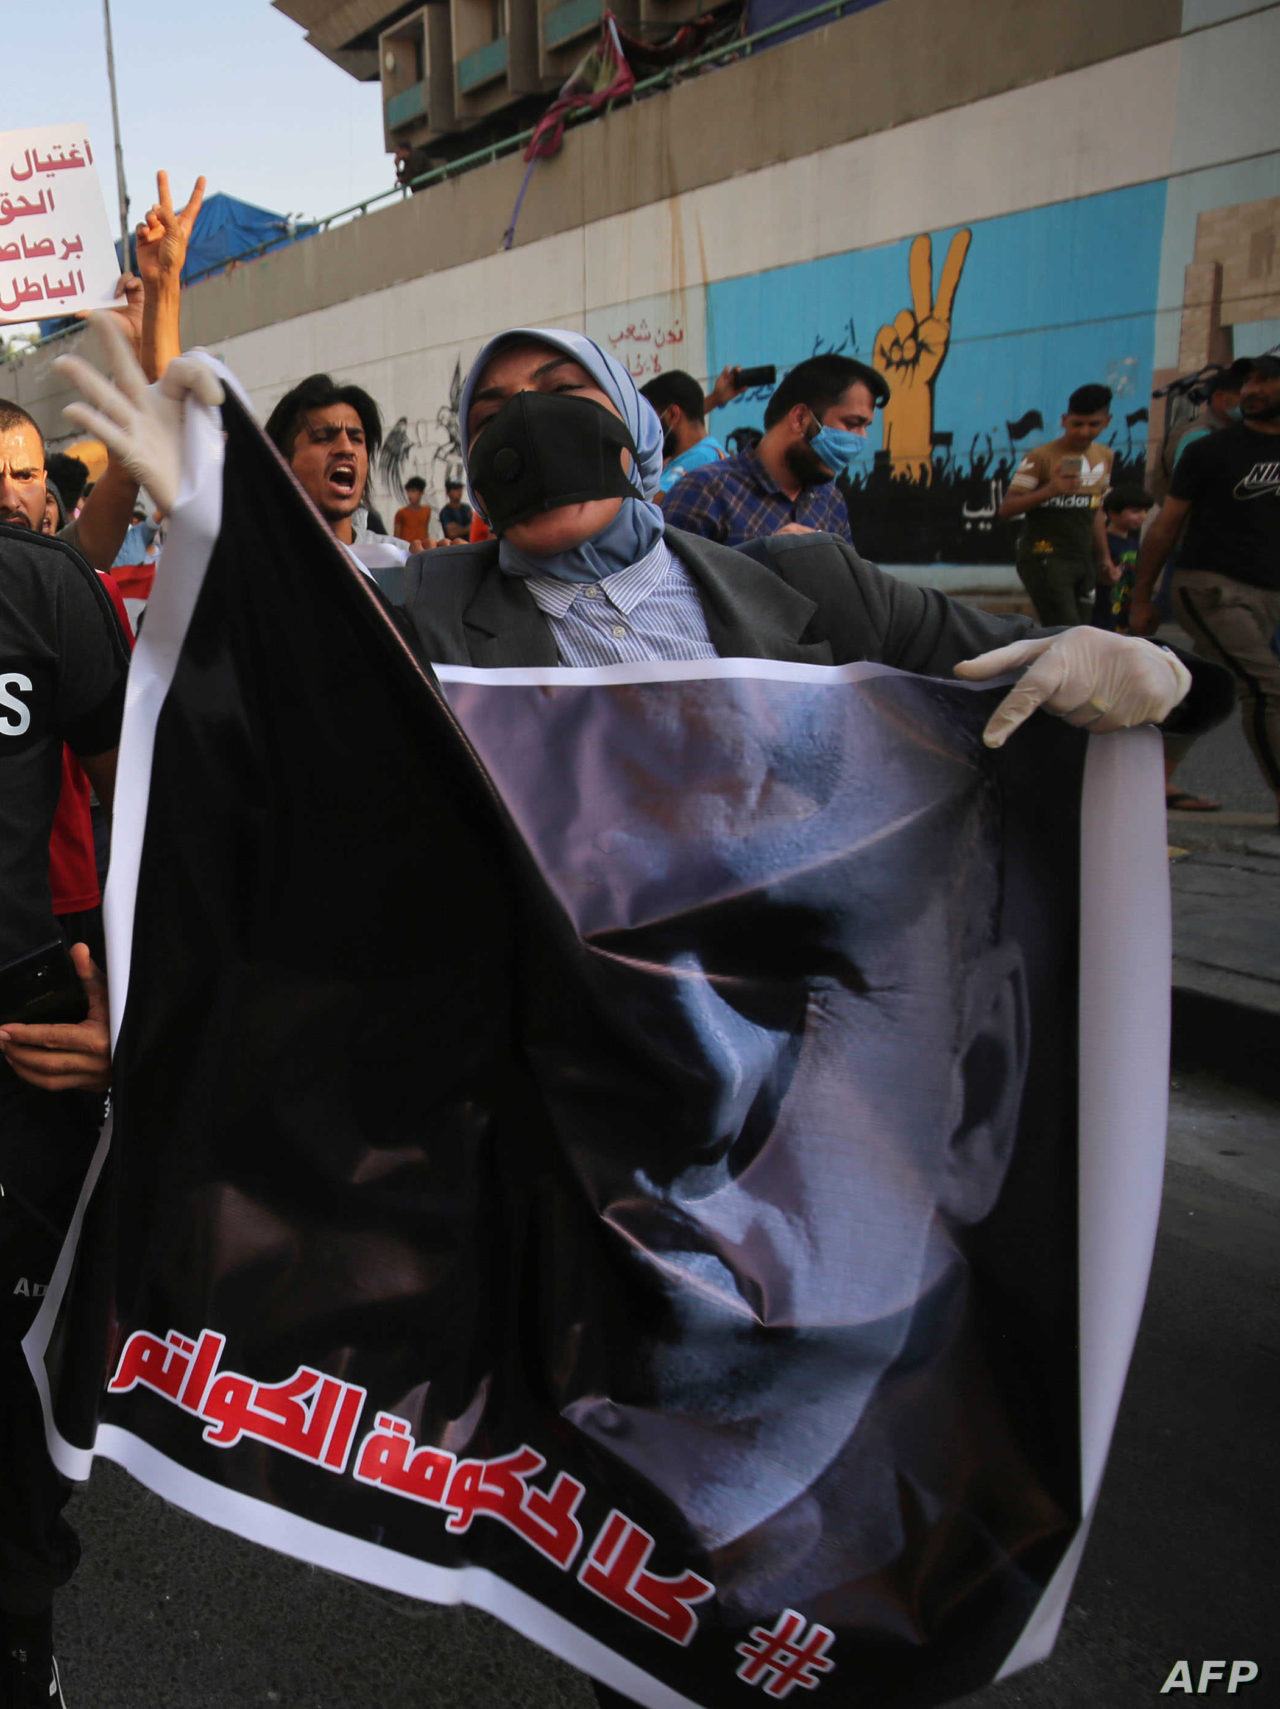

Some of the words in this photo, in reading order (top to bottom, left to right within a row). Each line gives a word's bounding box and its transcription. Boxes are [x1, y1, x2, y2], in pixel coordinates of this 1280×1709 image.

[10, 138, 94, 182] أغتيال
[107, 1328, 367, 1473] الكواتم
[577, 1509, 716, 1647] كلا
